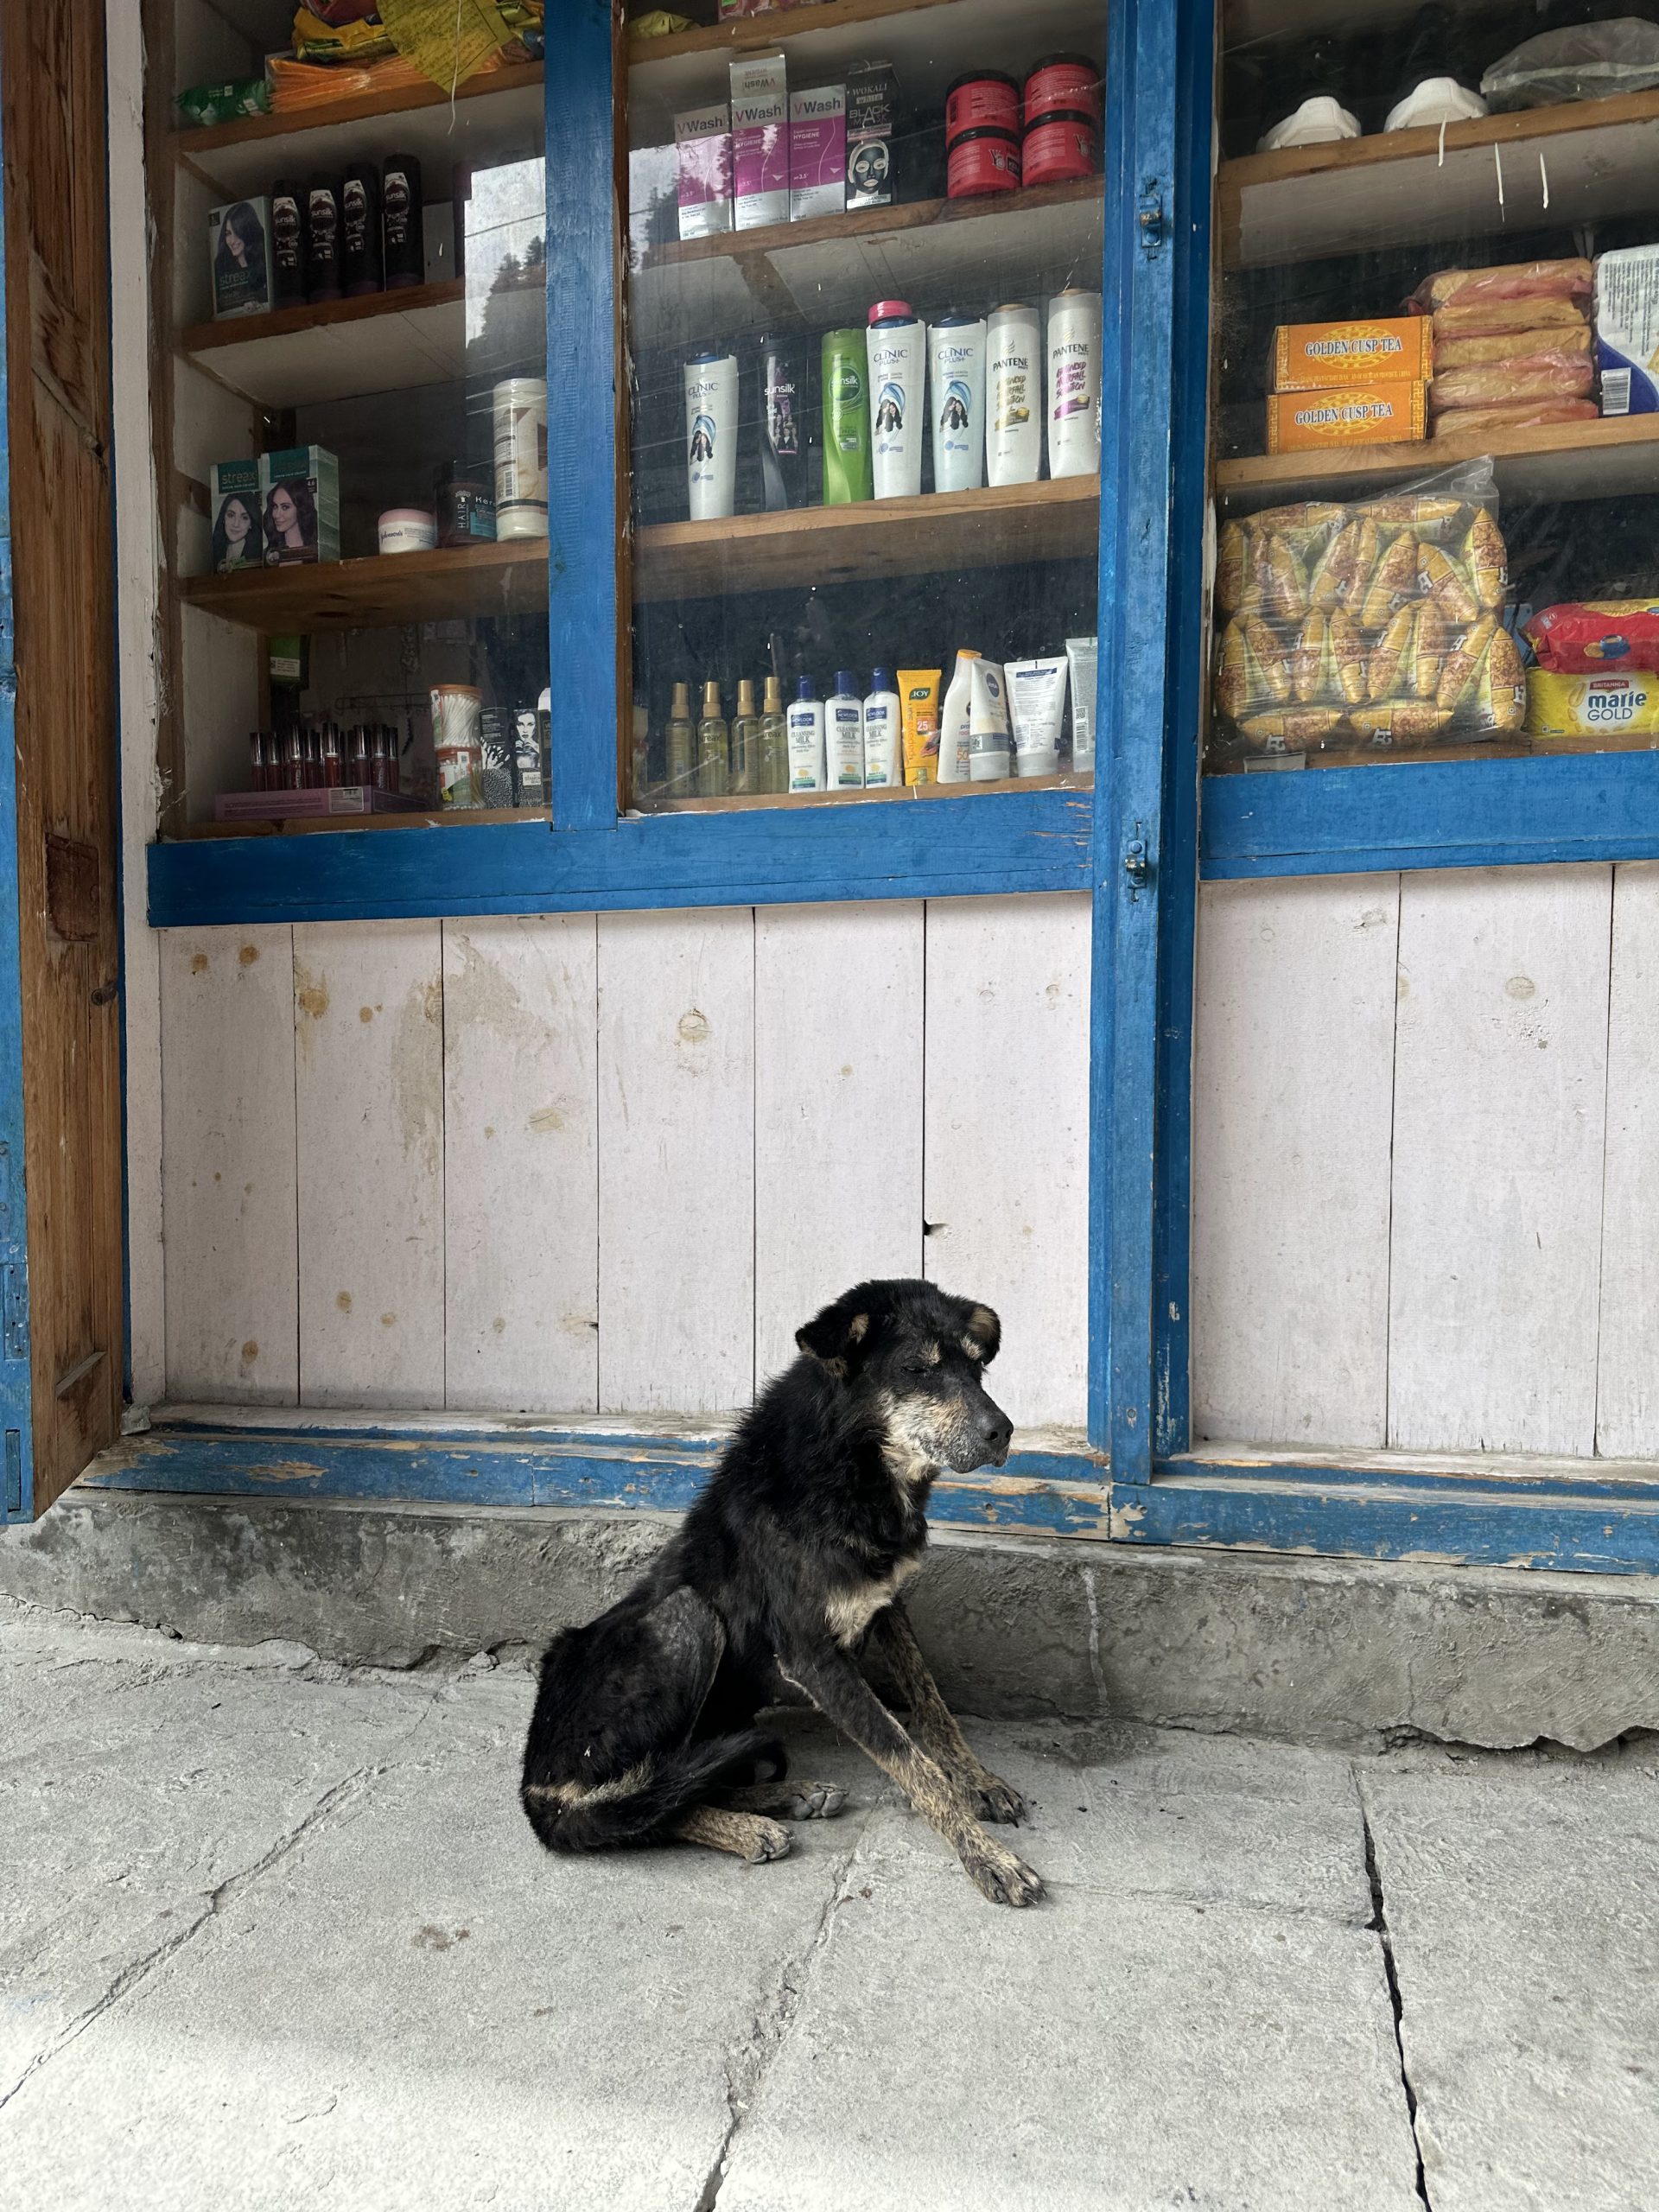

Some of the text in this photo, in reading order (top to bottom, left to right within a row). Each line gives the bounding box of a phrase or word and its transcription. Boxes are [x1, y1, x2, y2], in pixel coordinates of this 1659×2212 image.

[735, 105, 782, 123] VWash
[794, 97, 841, 117] VWash
[677, 118, 724, 135] VWash
[938, 346, 974, 359] CLINIC
[1052, 343, 1089, 359] PANTENE
[1305, 336, 1402, 356] GOLDEN CUSP TEA
[874, 349, 908, 363] CLINIC
[993, 357, 1028, 372] PANTENE
[688, 382, 719, 396] CLINIC
[765, 383, 796, 396] sunsilk
[1295, 403, 1393, 425] GOLDEN CUSP TEA
[221, 472, 257, 484] streax
[457, 503, 467, 529] HAIR
[1587, 708, 1633, 721] GOLD
[917, 720, 928, 732] 25
